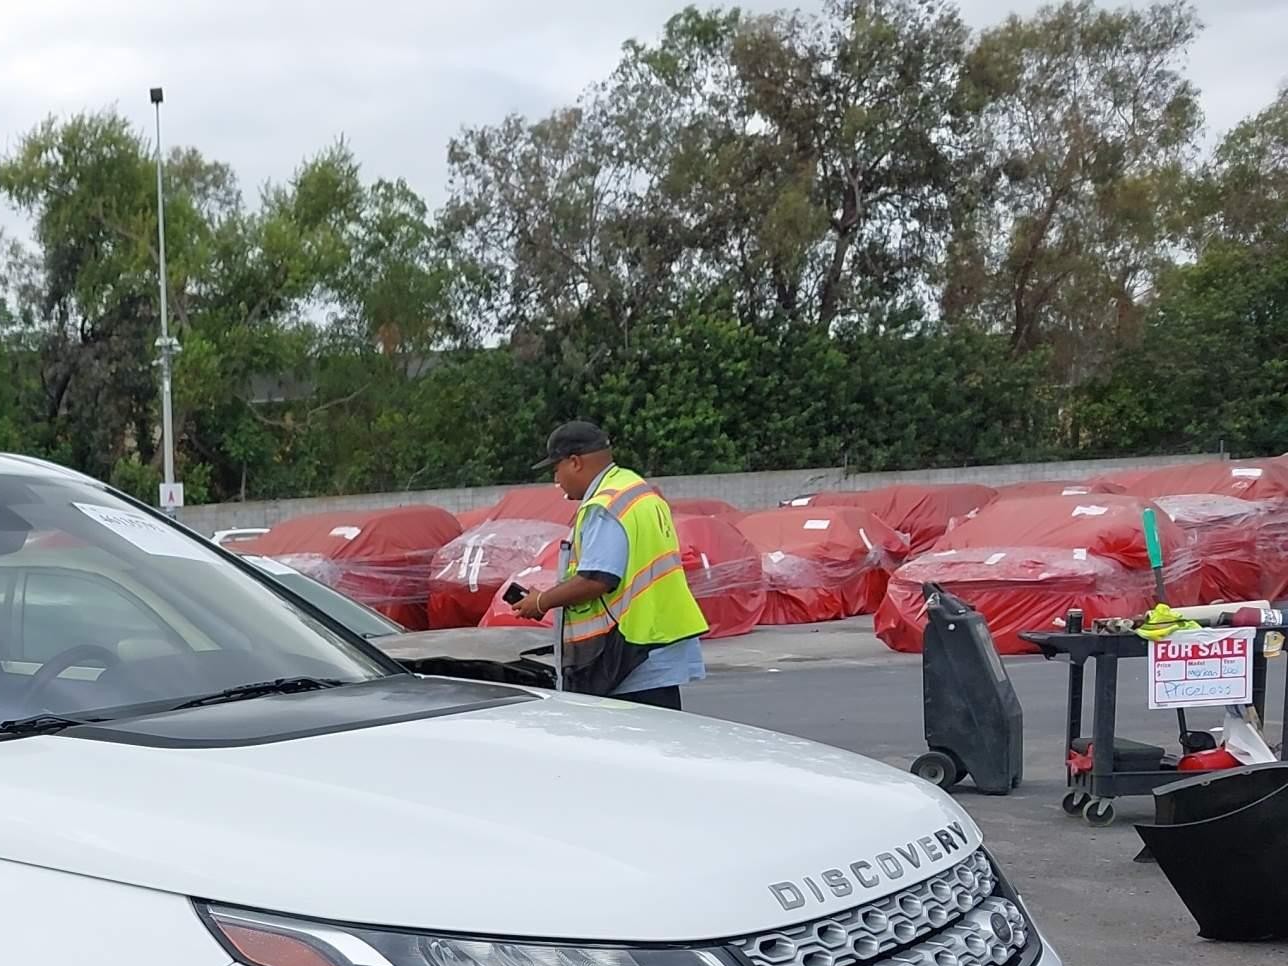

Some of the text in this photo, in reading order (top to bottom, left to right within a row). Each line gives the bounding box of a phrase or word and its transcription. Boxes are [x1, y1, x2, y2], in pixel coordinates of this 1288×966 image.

[1157, 640, 1245, 660] FOR SALE
[768, 821, 968, 911] DISCOVERY
